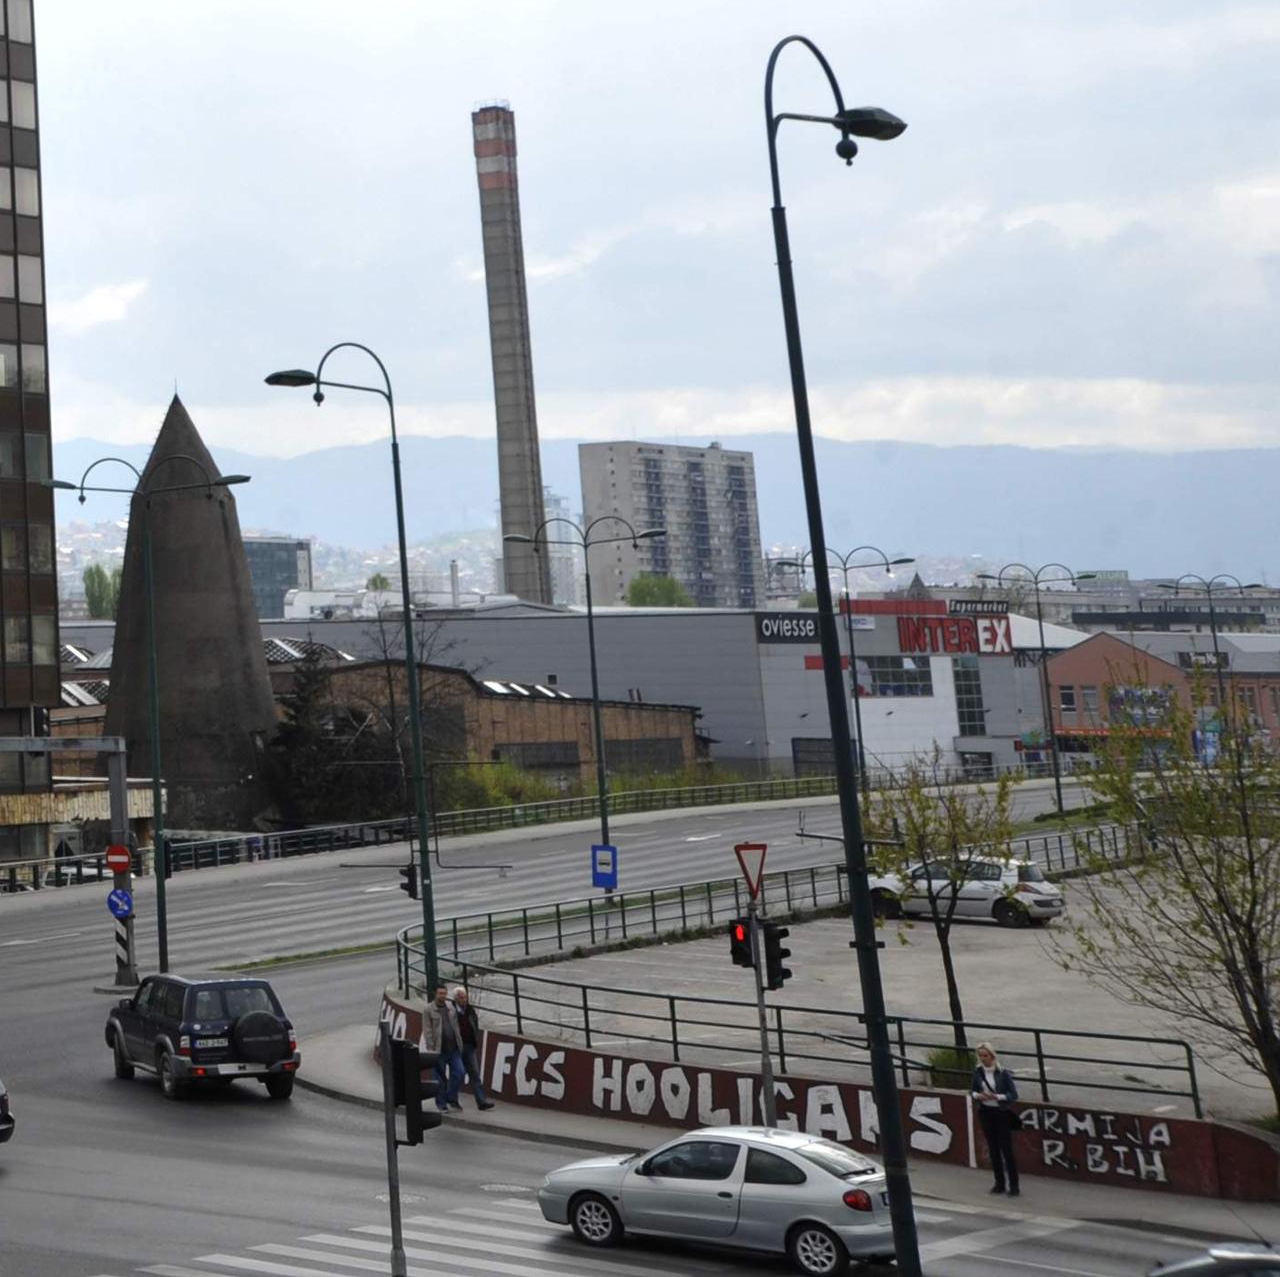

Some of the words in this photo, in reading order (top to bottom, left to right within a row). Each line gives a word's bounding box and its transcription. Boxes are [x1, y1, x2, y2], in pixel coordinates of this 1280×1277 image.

[762, 614, 815, 636] oviesse
[897, 616, 1011, 653] INTEREX
[491, 1042, 565, 1100] FCS
[1019, 1108, 1171, 1147] ARMIJA
